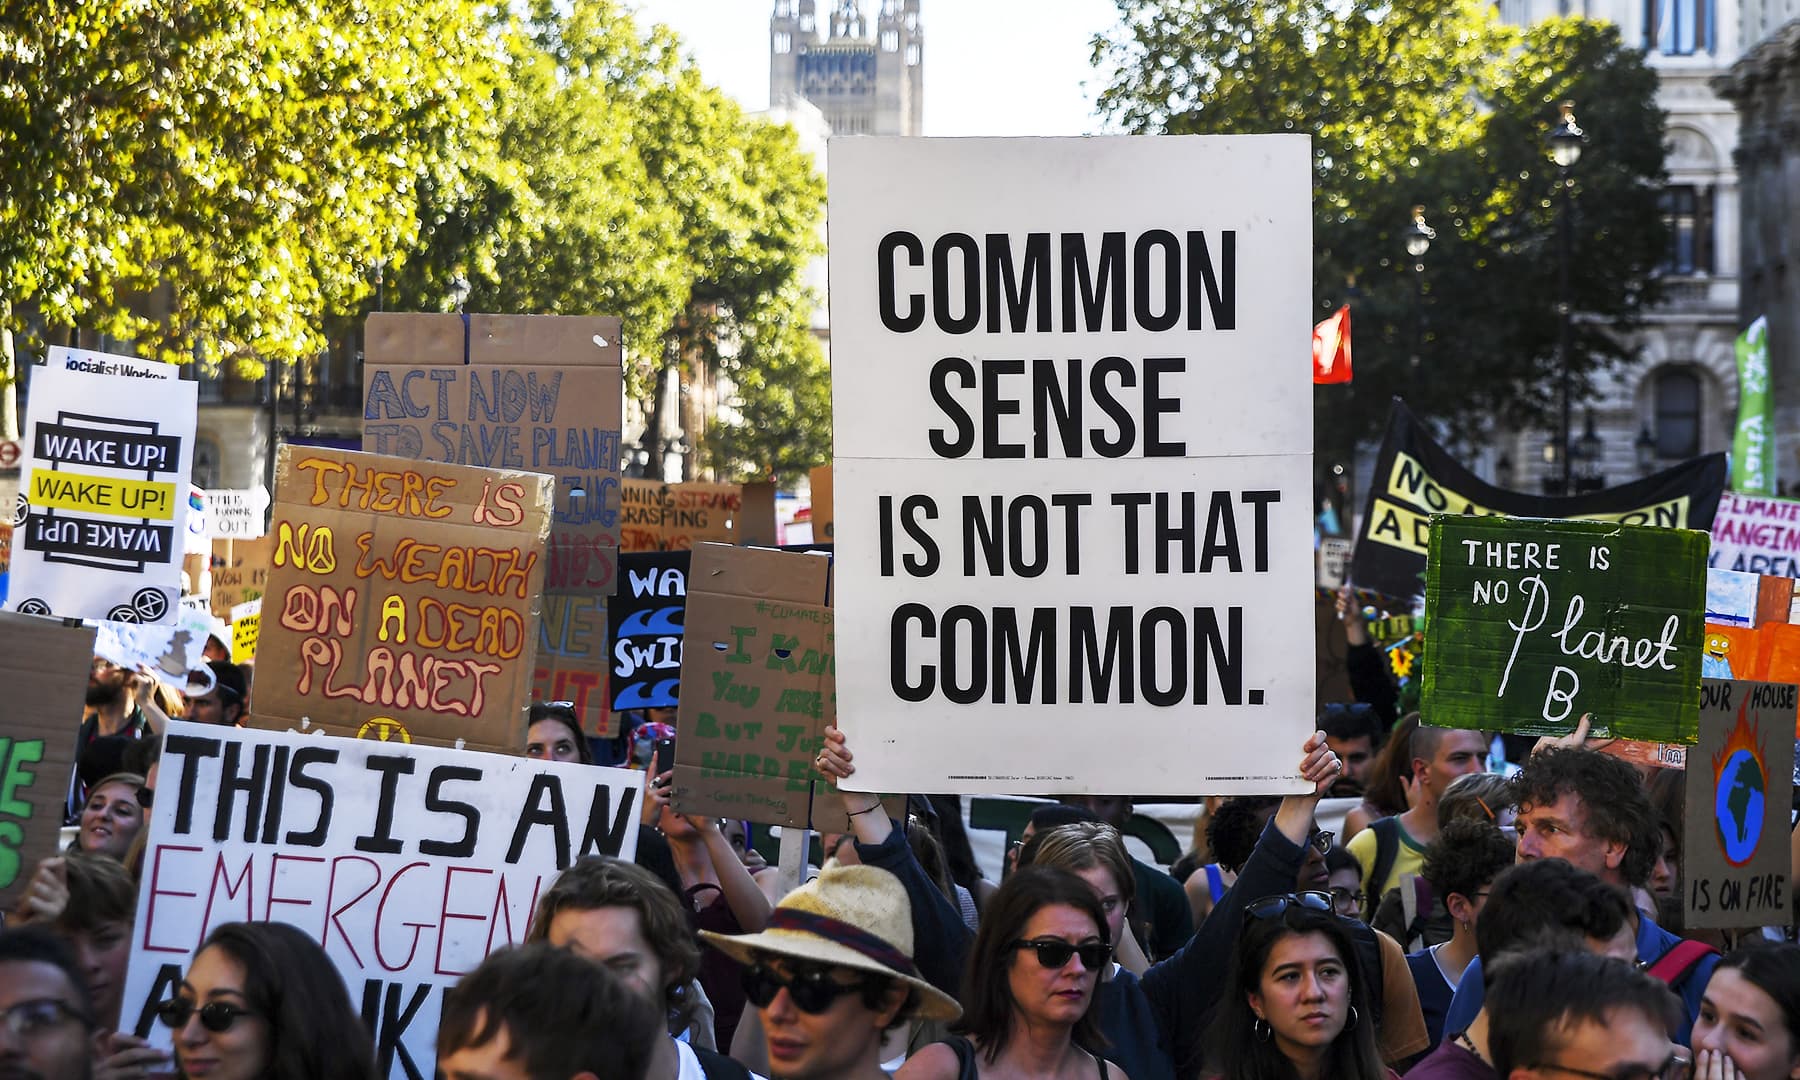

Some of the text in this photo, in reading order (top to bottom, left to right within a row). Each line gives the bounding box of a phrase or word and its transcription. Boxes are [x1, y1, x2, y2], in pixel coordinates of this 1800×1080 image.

[877, 229, 1237, 335] COMMON
[65, 355, 119, 376] ocialist
[364, 369, 563, 424] ACT NOW
[928, 356, 1187, 459] SENSE
[44, 433, 167, 469] WAKE UP!
[364, 422, 621, 473] TO SAVE PLANET
[37, 476, 166, 511] WAKE UP!
[296, 457, 458, 518] THERE
[1396, 459, 1448, 511] NO
[37, 518, 79, 544] UP!
[86, 523, 161, 552] WAKE
[879, 493, 941, 578] IS
[962, 493, 1093, 578] NOT
[1110, 489, 1281, 576] THAT
[1461, 539, 1611, 570] THERE IS
[273, 520, 538, 598] NO WEALTH
[280, 583, 525, 660] ON A DEAD
[725, 625, 757, 665] I
[1472, 573, 1679, 698] NO Planet
[297, 636, 502, 718] PLANET
[614, 636, 684, 678] SWI
[890, 602, 1266, 708] COMMON.
[1542, 665, 1580, 722] B
[1751, 684, 1796, 710] HOUSE
[165, 734, 638, 871] THIS IS AN
[1692, 873, 1785, 912] IS ON FIRE
